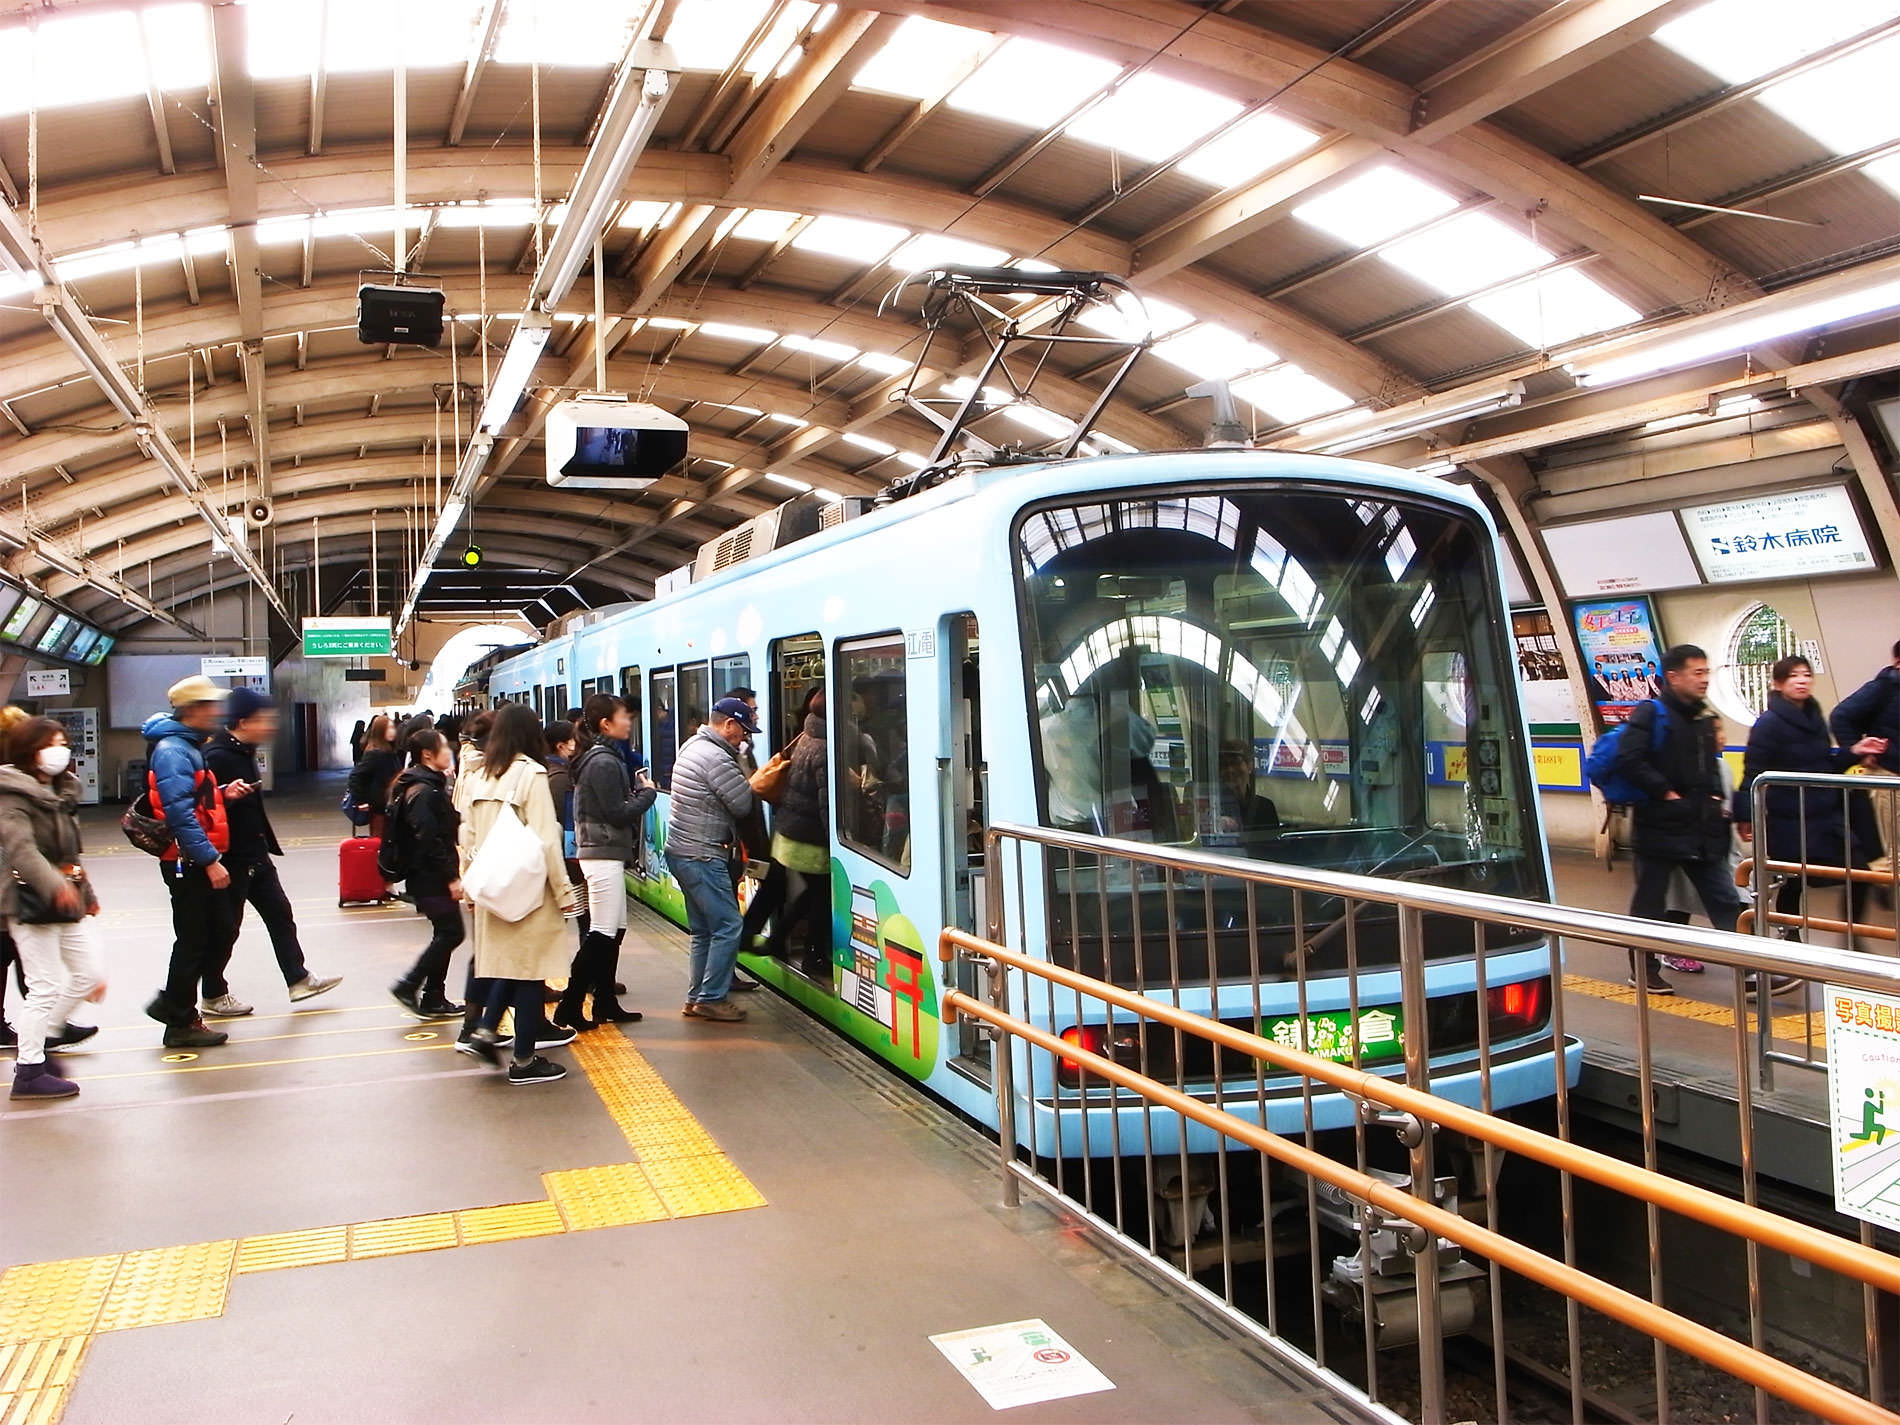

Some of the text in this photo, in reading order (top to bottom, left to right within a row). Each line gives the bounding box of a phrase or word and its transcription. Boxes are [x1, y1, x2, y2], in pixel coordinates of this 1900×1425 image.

[1733, 524, 1843, 554] 鈴木病院
[1272, 1010, 1396, 1051] 鎌倉
[1308, 1044, 1369, 1058] AMAKUA
